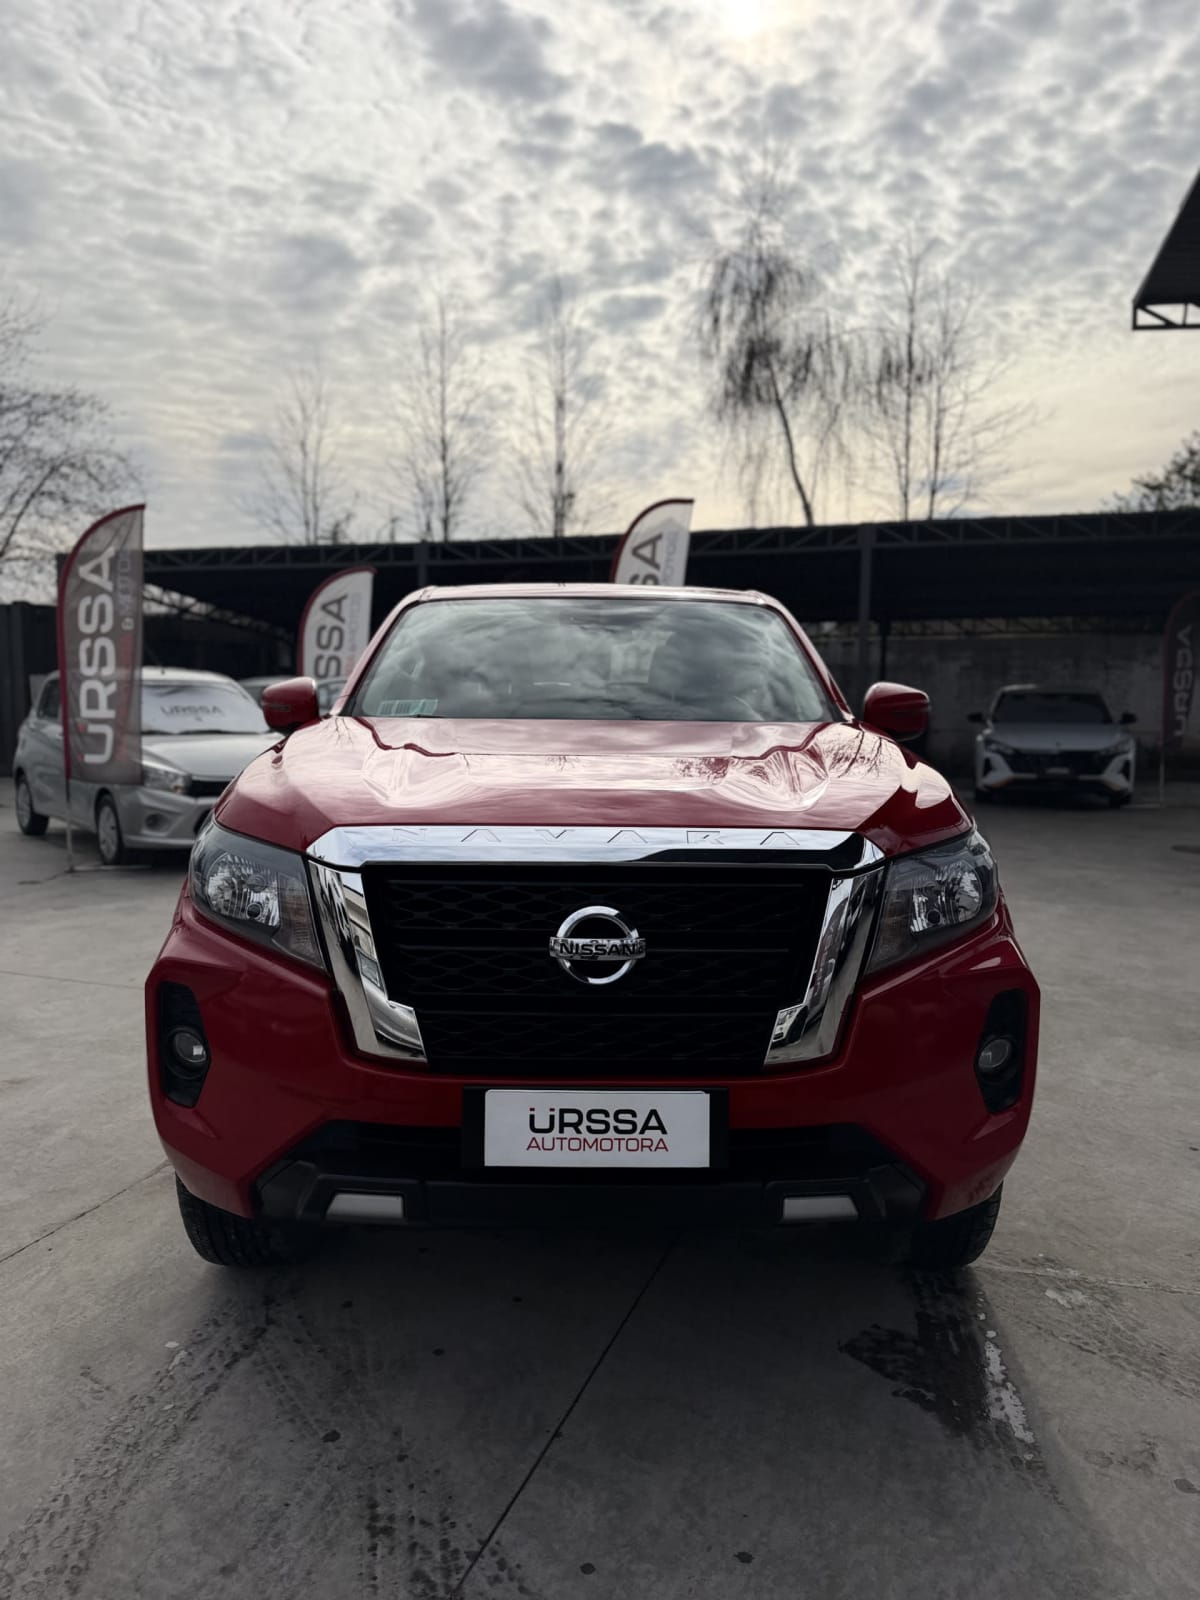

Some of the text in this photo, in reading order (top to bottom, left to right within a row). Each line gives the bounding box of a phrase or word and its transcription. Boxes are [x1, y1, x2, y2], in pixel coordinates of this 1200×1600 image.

[392, 828, 800, 845] NAVARA
[560, 939, 636, 956] NISSAN
[526, 1136, 669, 1152] AUTOMOTORA
